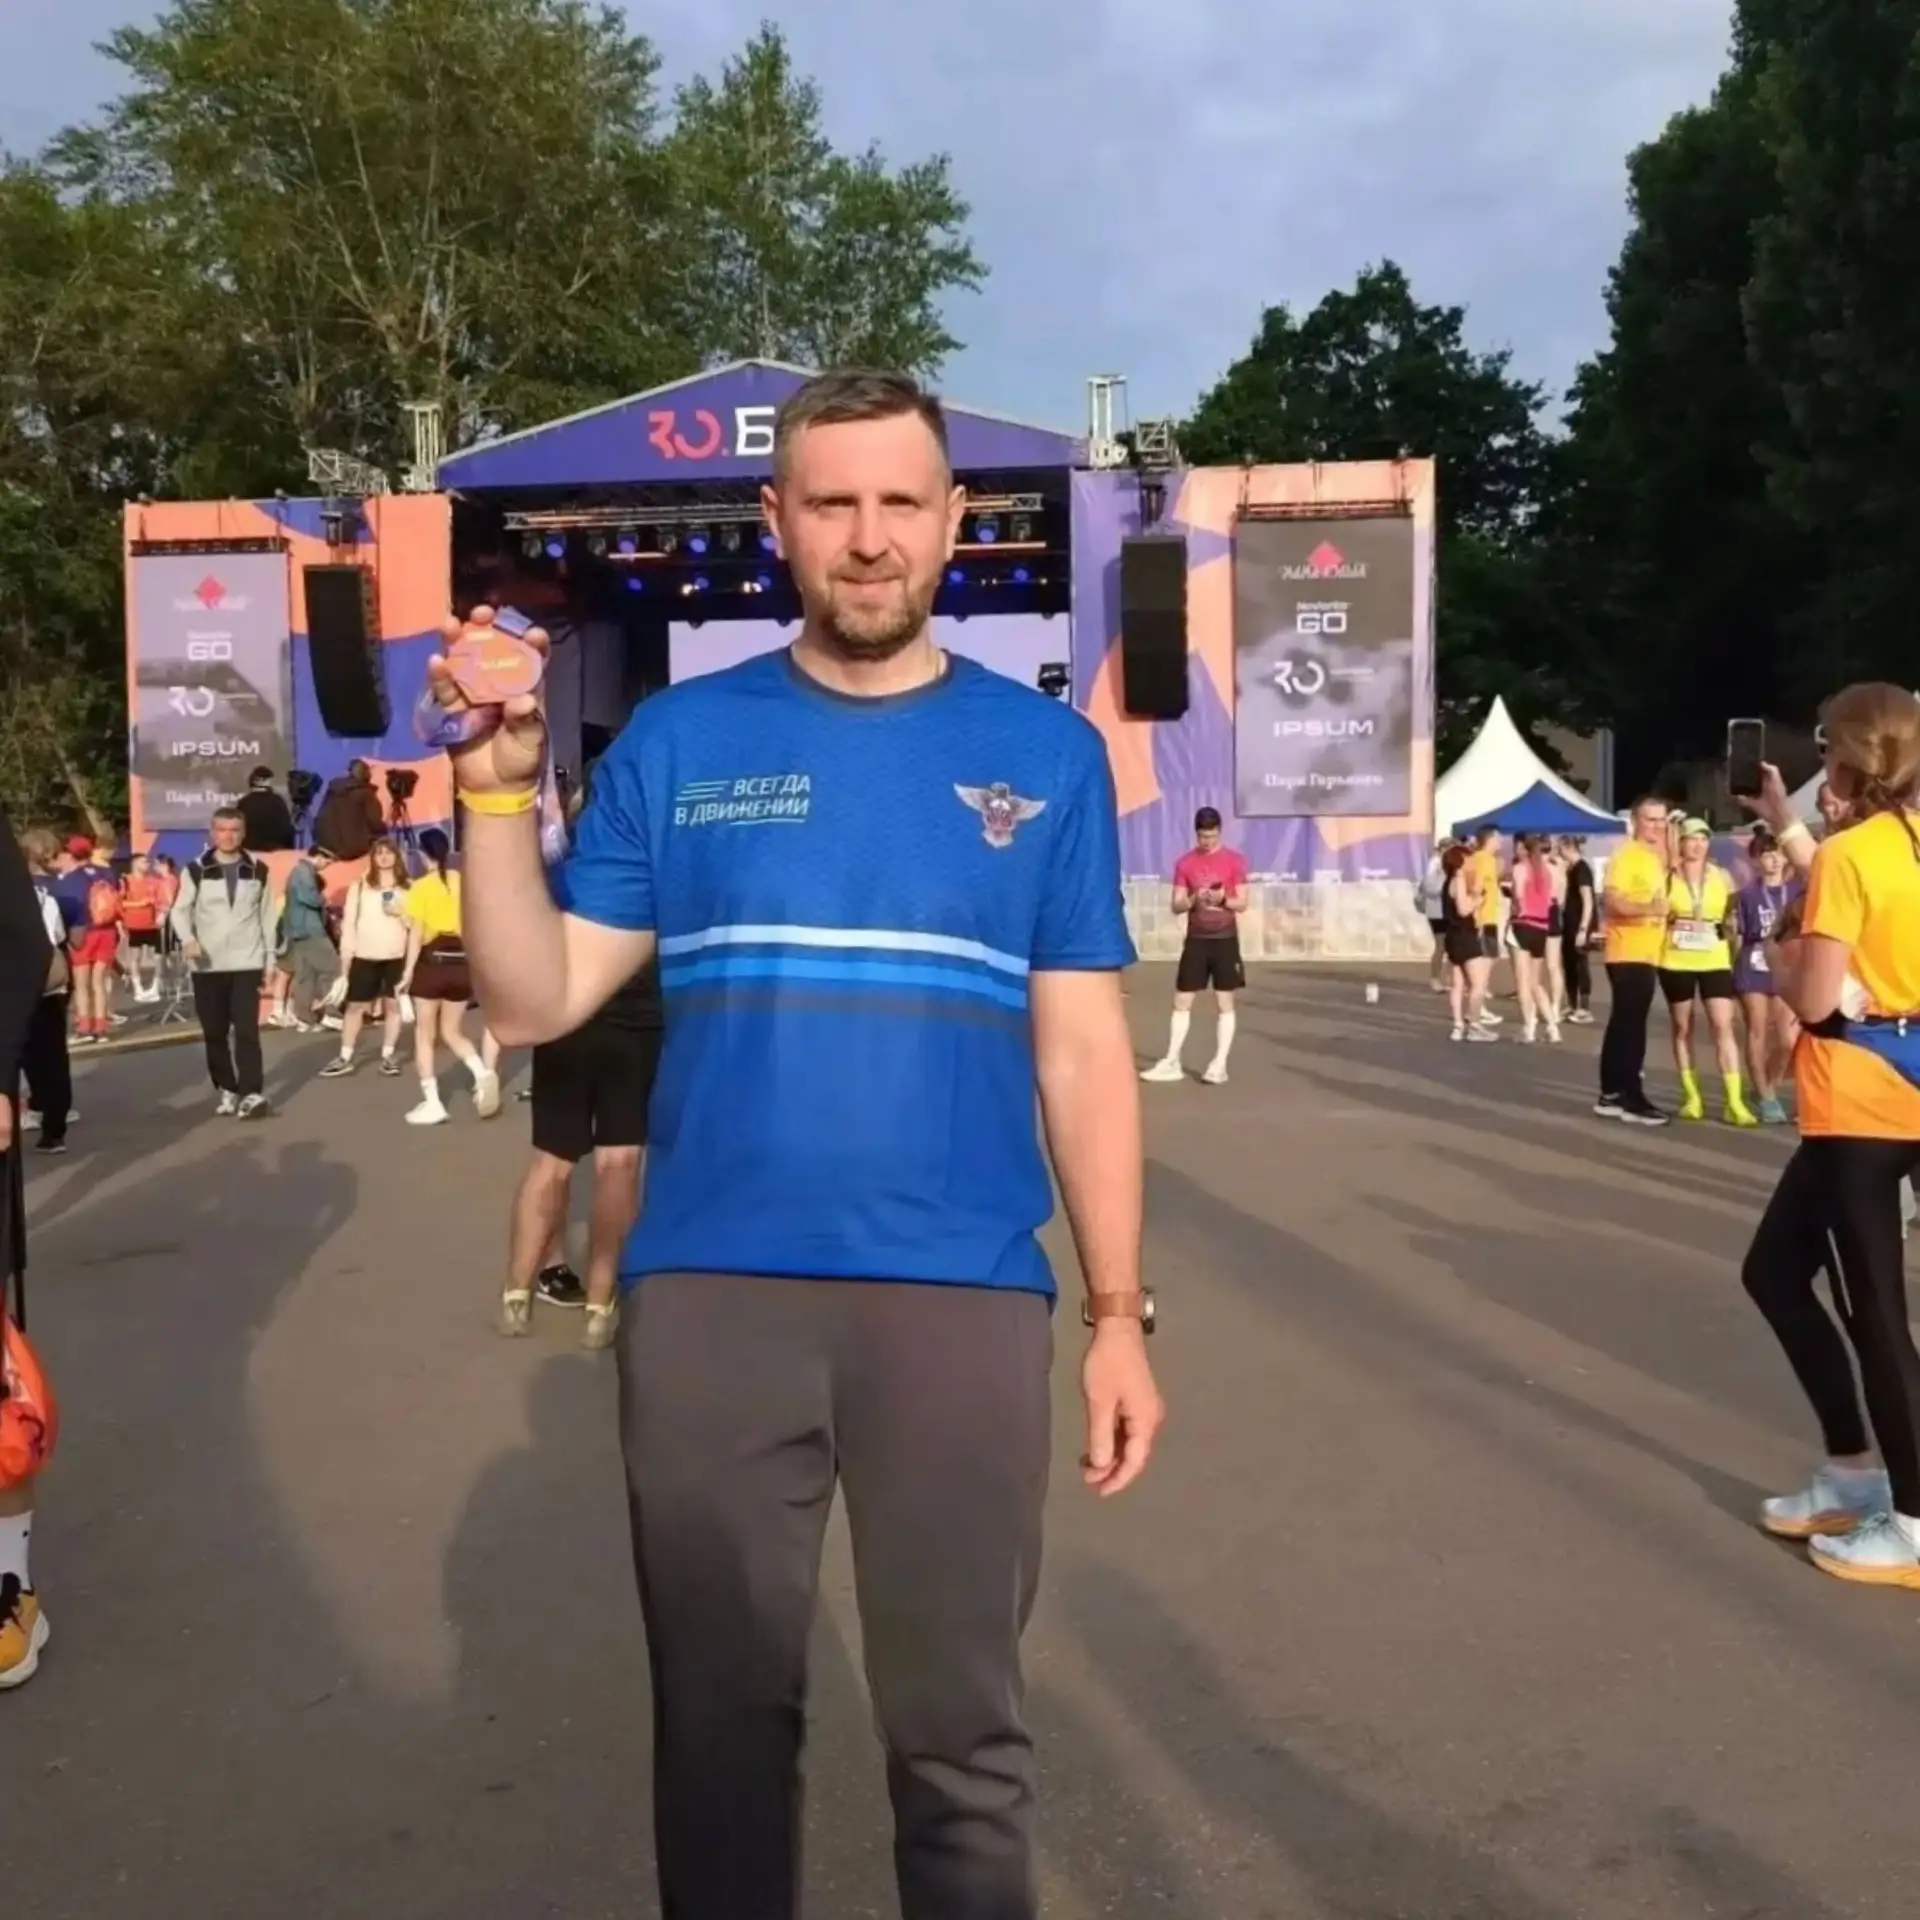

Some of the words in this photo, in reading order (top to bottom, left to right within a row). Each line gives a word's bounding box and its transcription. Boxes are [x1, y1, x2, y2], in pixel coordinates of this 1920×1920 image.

[1296, 612, 1348, 633] GO
[187, 641, 233, 660] GO
[1273, 720, 1374, 737] IPSUM
[172, 741, 260, 756] IPSUM
[733, 774, 812, 797] ВСЕГДА
[674, 807, 688, 826] В
[689, 798, 809, 827] ДВИЖЕНИИ
